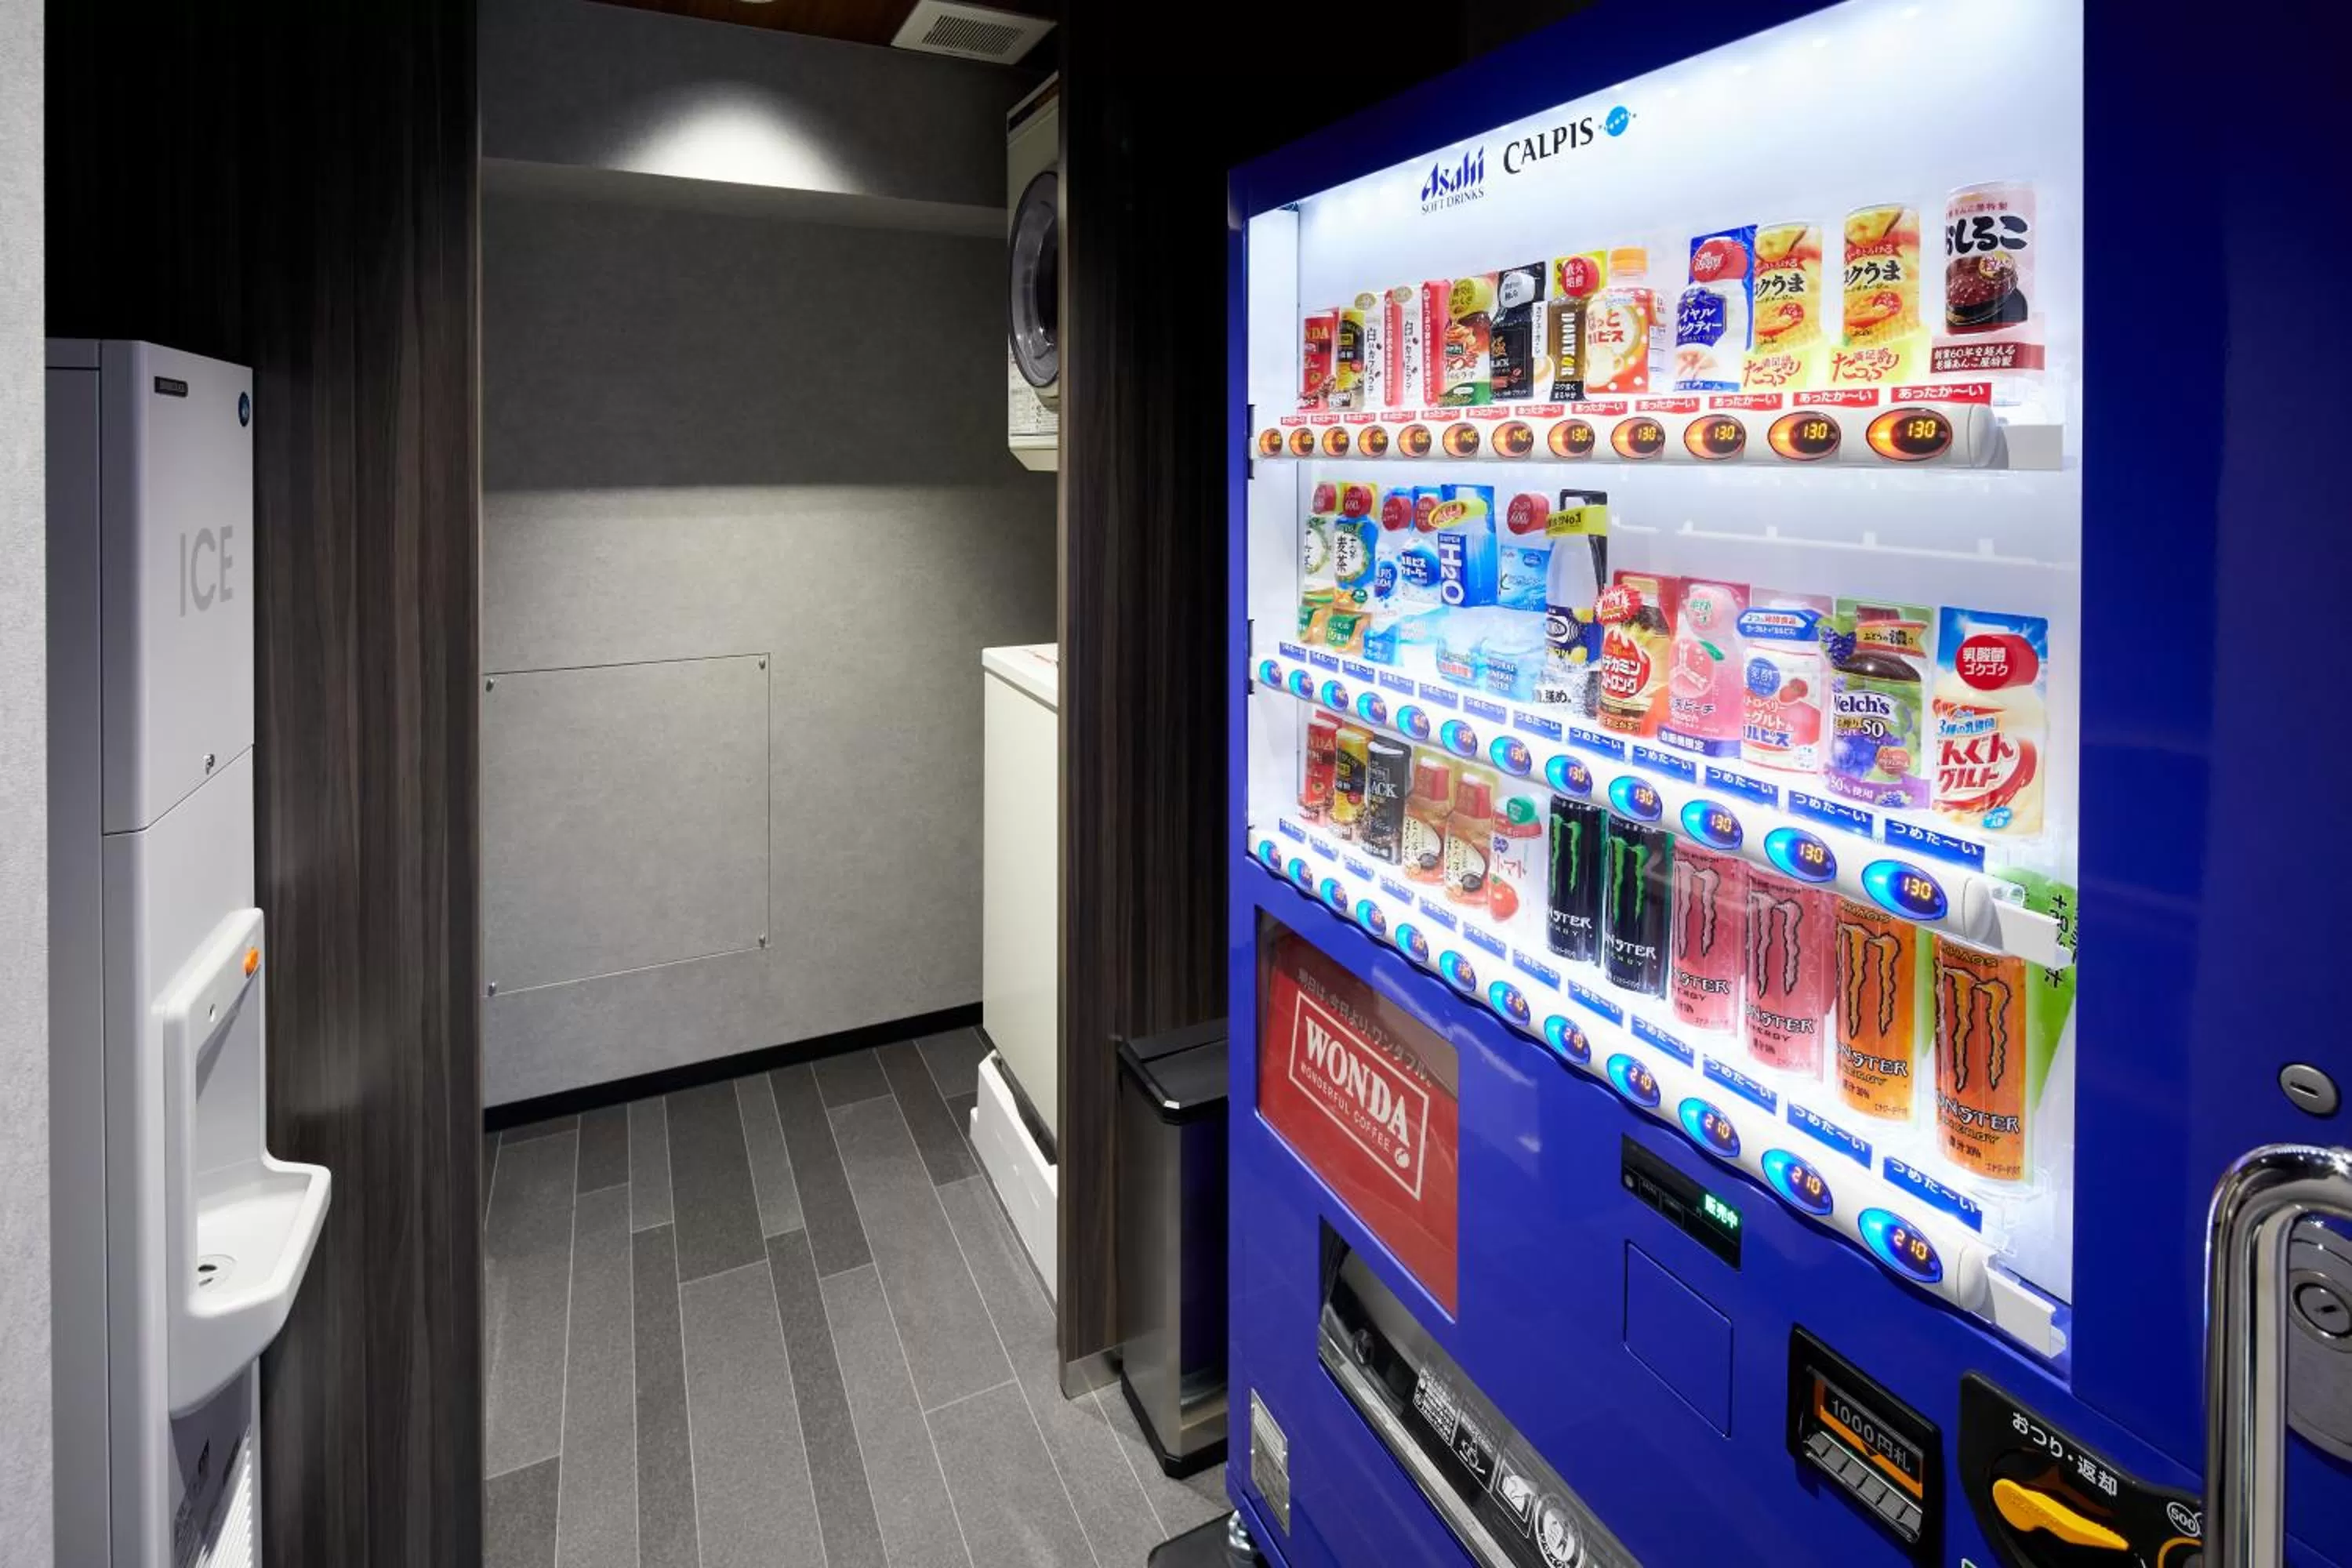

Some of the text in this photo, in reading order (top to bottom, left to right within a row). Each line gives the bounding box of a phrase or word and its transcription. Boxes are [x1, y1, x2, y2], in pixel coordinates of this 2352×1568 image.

[1503, 117, 1594, 175] CALPIS
[1421, 146, 1484, 201] Asahi
[1421, 189, 1485, 215] SOFT DRINKS
[1638, 426, 1657, 441] 130
[1714, 425, 1735, 440] 130
[1804, 423, 1828, 440] 130
[1907, 421, 1936, 437] 130
[179, 524, 234, 617] ICE
[1440, 544, 1465, 605] H2O
[1861, 720, 1884, 738] 50
[1637, 746, 1692, 771] つめた〜い
[1710, 768, 1773, 795] つめた〜い
[1634, 787, 1654, 806] 130
[1794, 793, 1867, 823] つめた〜い
[1711, 814, 1733, 832] 130
[1798, 841, 1824, 863] 130
[1893, 821, 1979, 855] つめた〜い
[1903, 875, 1933, 901] 130
[1305, 1014, 1411, 1149] WONDA
[1629, 1066, 1653, 1091] 210
[1300, 1061, 1392, 1156] WONDERFUL COFFEE
[1704, 1112, 1730, 1138] 210
[1793, 1104, 1866, 1153] つめた〜い
[1791, 1165, 1822, 1196] 210
[1890, 1157, 1977, 1214] つめた〜い
[1893, 1229, 1928, 1261] 210
[1831, 1398, 1911, 1473] 1000円札
[2012, 1412, 2118, 1497] おつり・返却
